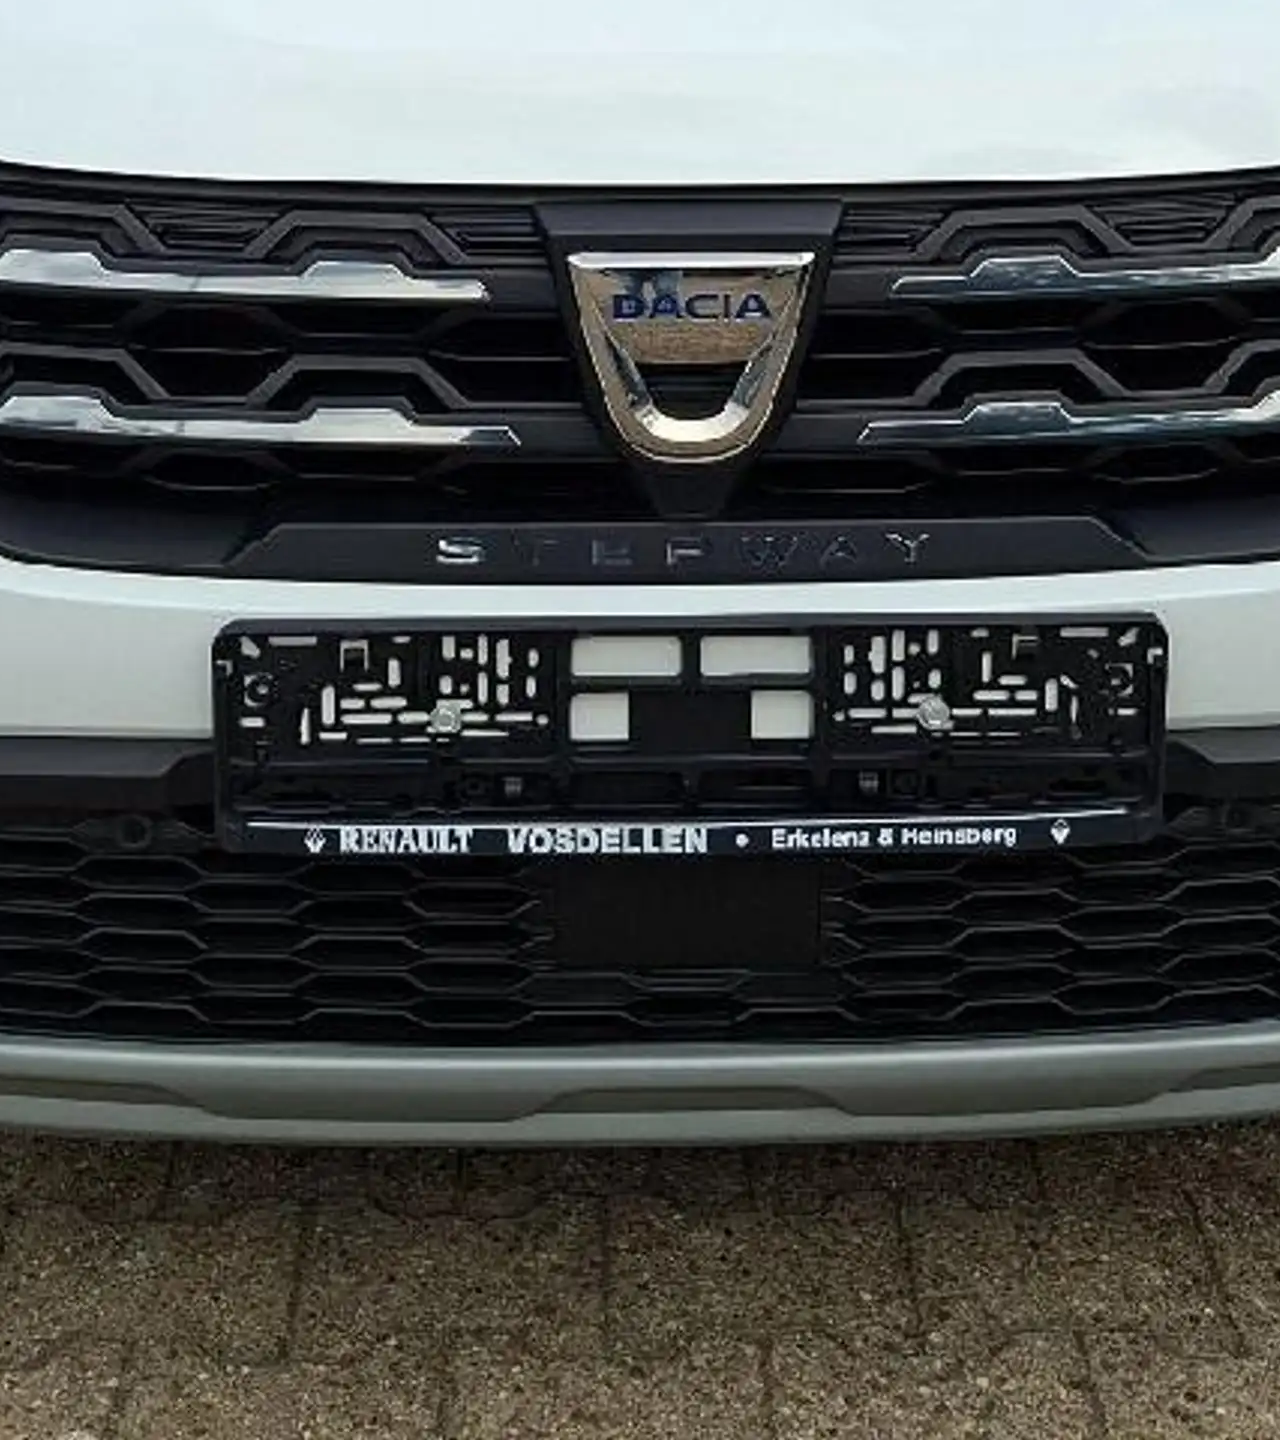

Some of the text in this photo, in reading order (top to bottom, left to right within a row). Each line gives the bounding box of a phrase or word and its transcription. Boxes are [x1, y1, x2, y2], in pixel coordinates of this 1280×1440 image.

[613, 294, 771, 319] DACIA
[436, 534, 929, 566] STEPWAY
[340, 826, 1017, 853] RENAULT VOSDELLEN Erkelenz & Heinsberg
